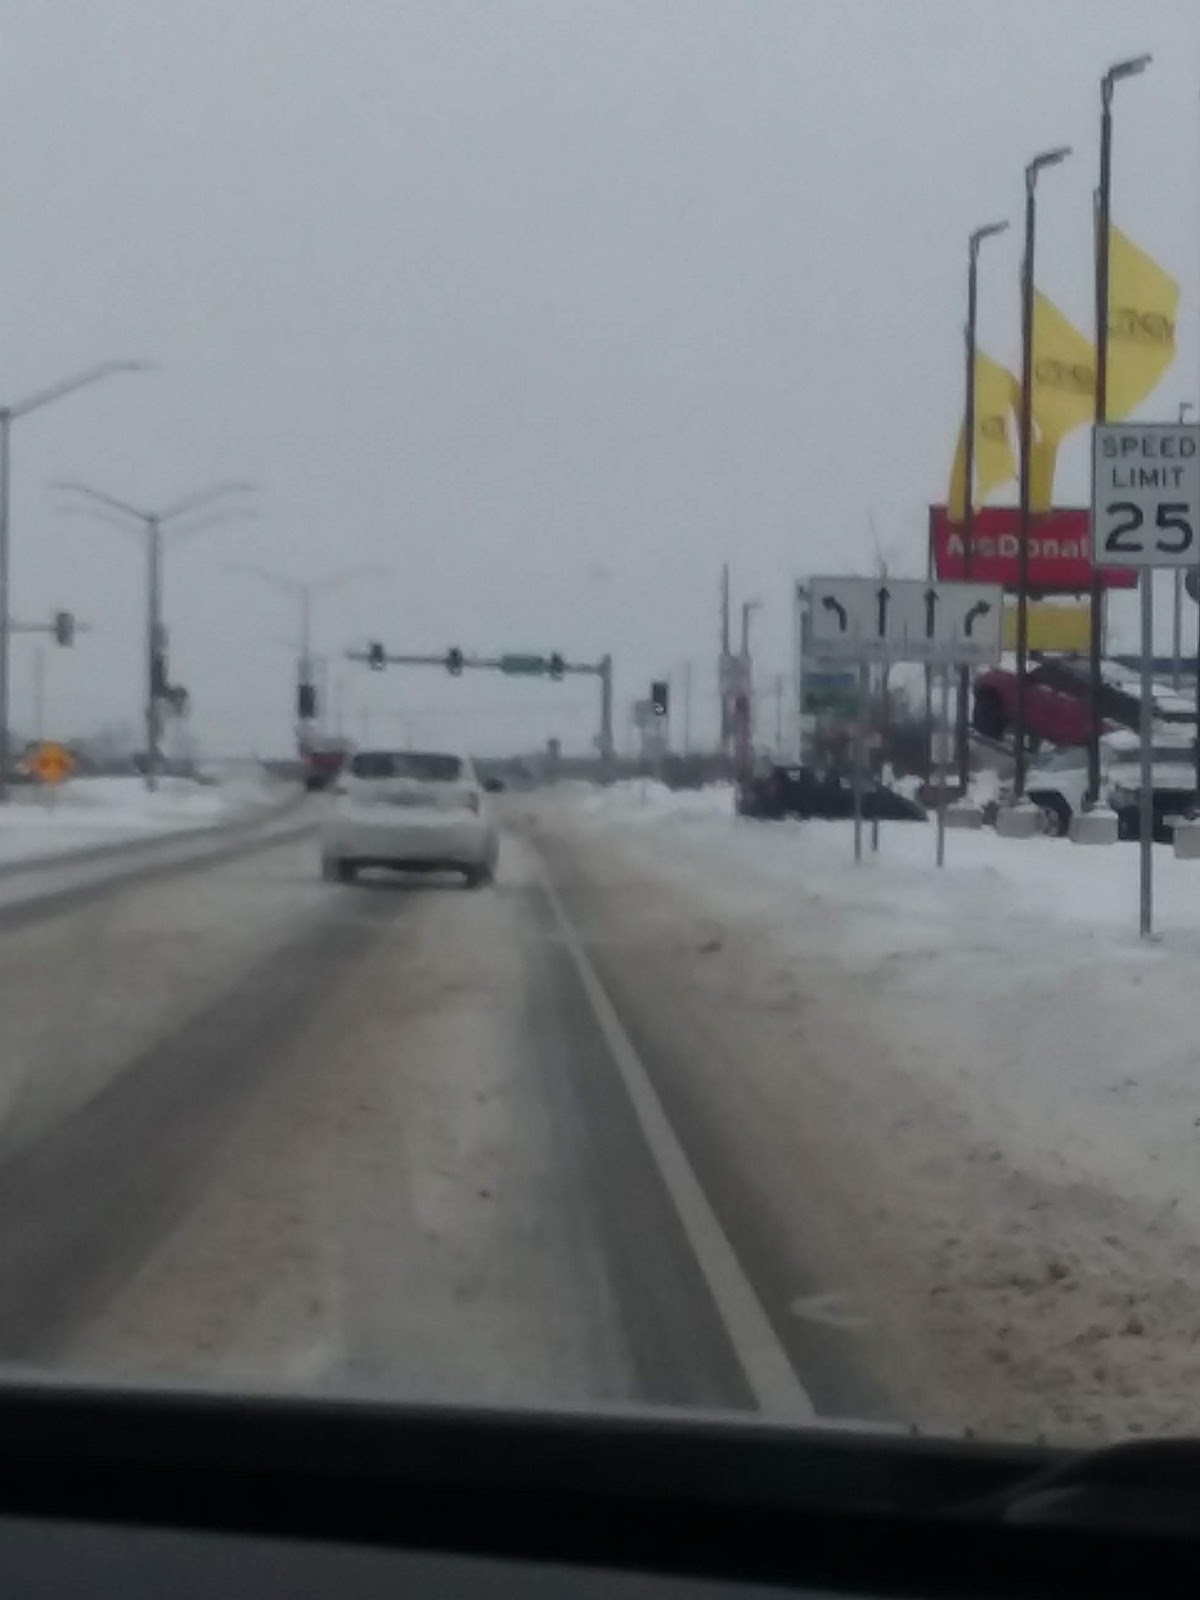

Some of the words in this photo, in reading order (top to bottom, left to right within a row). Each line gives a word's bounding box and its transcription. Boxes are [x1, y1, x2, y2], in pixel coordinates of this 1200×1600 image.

[1102, 434, 1196, 458] SPEED
[1112, 465, 1185, 488] LIMIT
[1105, 502, 1193, 553] 25
